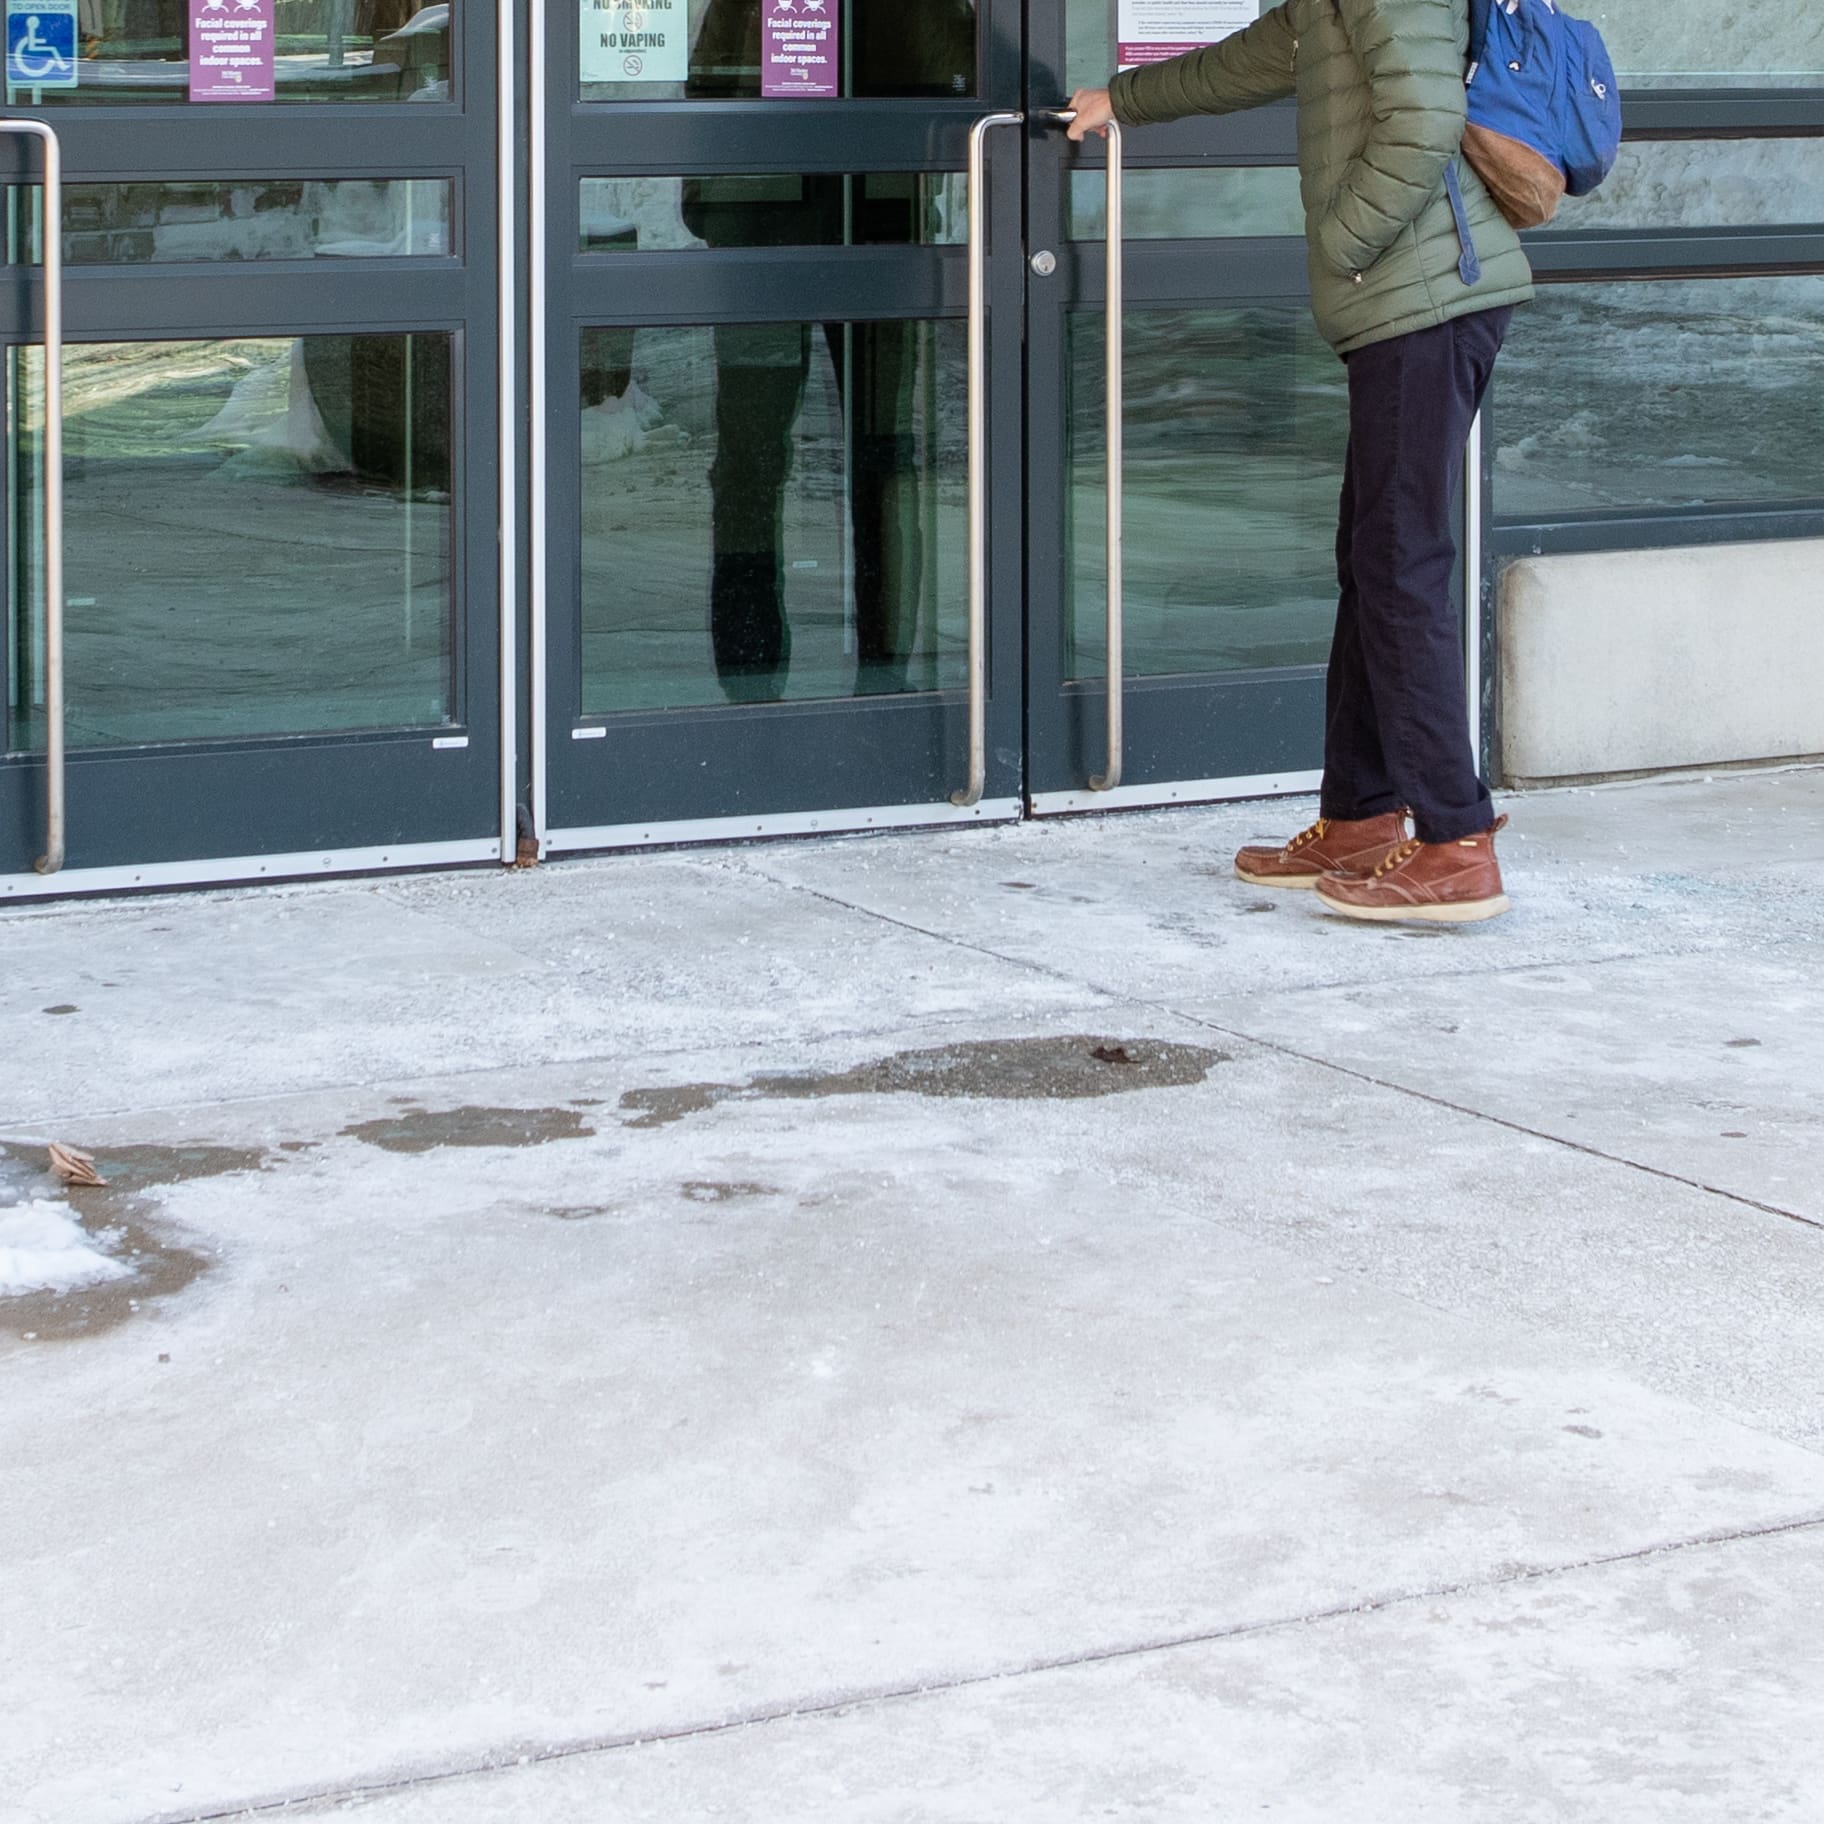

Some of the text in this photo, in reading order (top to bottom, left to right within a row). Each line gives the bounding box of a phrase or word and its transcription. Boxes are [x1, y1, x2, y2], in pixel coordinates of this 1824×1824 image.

[195, 18, 268, 30] Facial coverings
[767, 18, 832, 30] Facial coverings
[200, 30, 262, 43] required in all
[600, 33, 666, 48] NO VAPING
[772, 30, 827, 42] required in all
[782, 43, 817, 52] common
[199, 55, 228, 66] indoor
[771, 53, 828, 66] indoor spaces.
